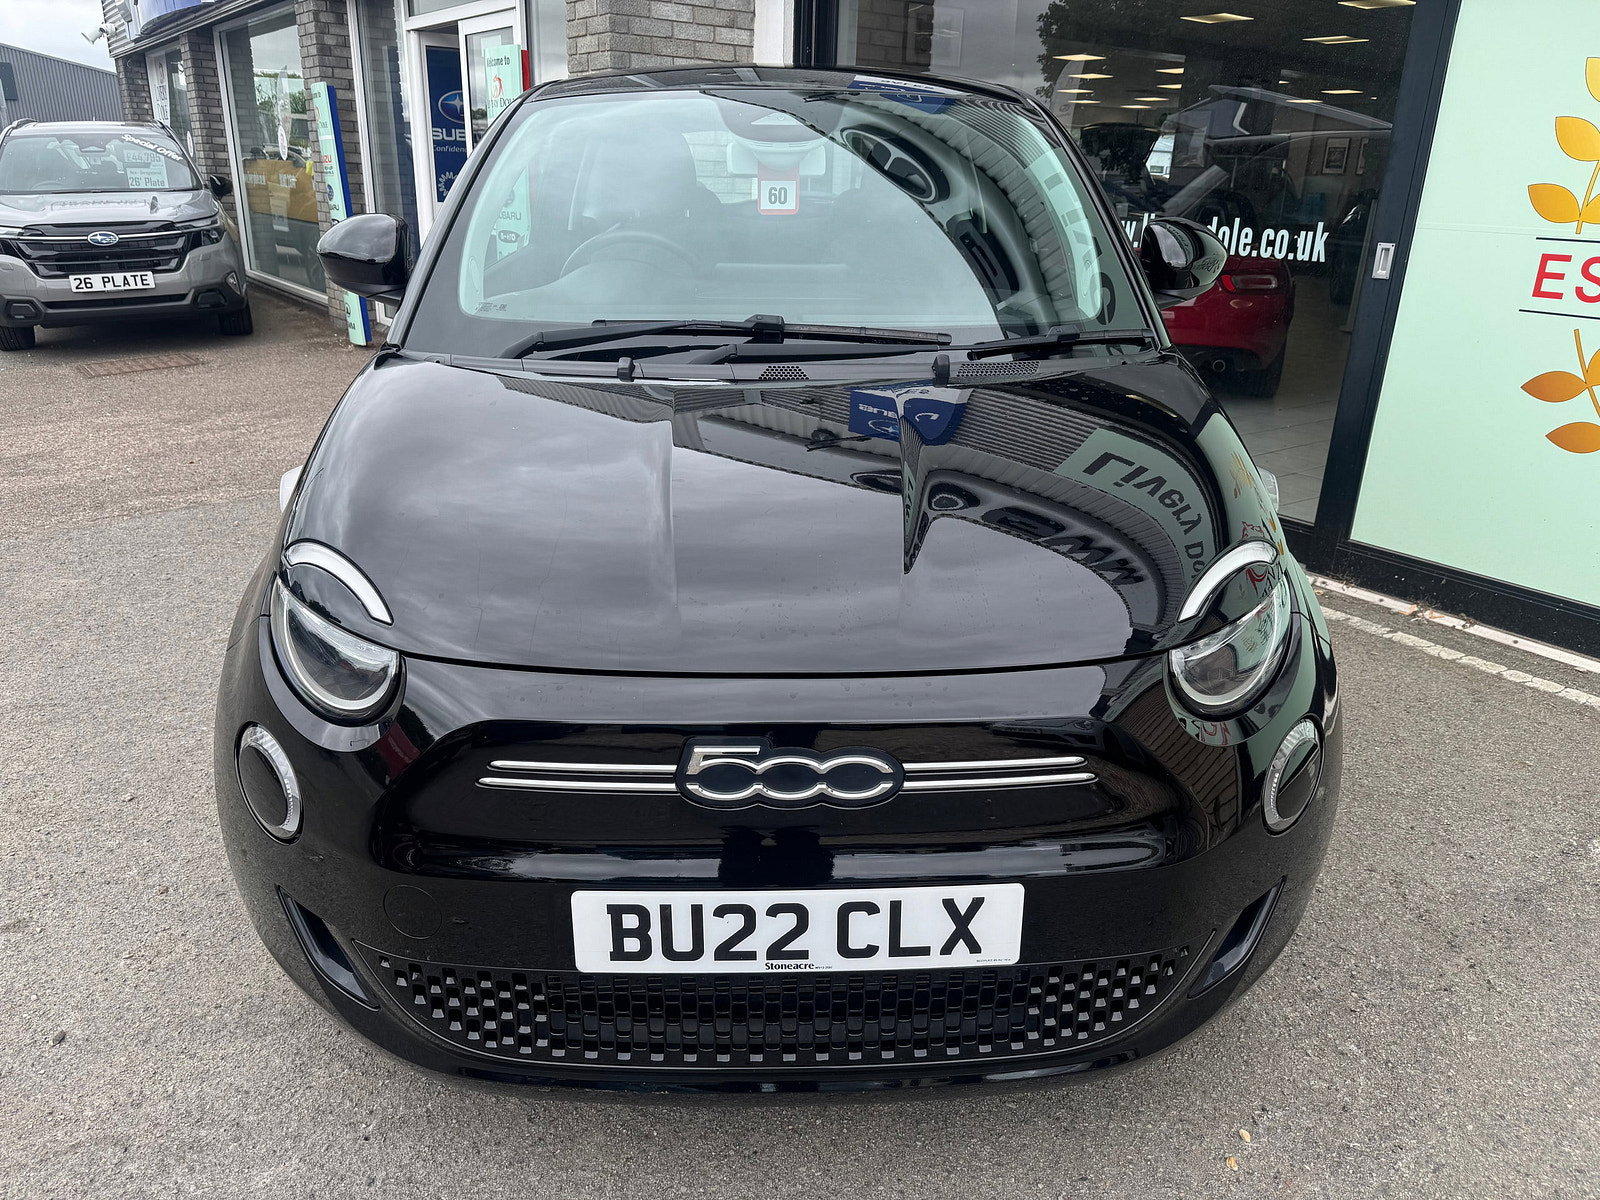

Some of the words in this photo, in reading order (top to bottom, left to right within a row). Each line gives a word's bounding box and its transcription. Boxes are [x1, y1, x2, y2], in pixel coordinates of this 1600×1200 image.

[504, 56, 511, 66] to
[121, 134, 158, 150] Special
[157, 147, 184, 161] Offer
[144, 176, 165, 187] Plate
[768, 186, 788, 205] 60
[73, 277, 94, 290] 26
[101, 274, 151, 288] PLATE
[1532, 252, 1600, 303] ES
[686, 746, 894, 801] 500
[606, 902, 810, 962] BU22
[836, 896, 986, 959] CLX
[765, 962, 815, 970] Stoneacre
